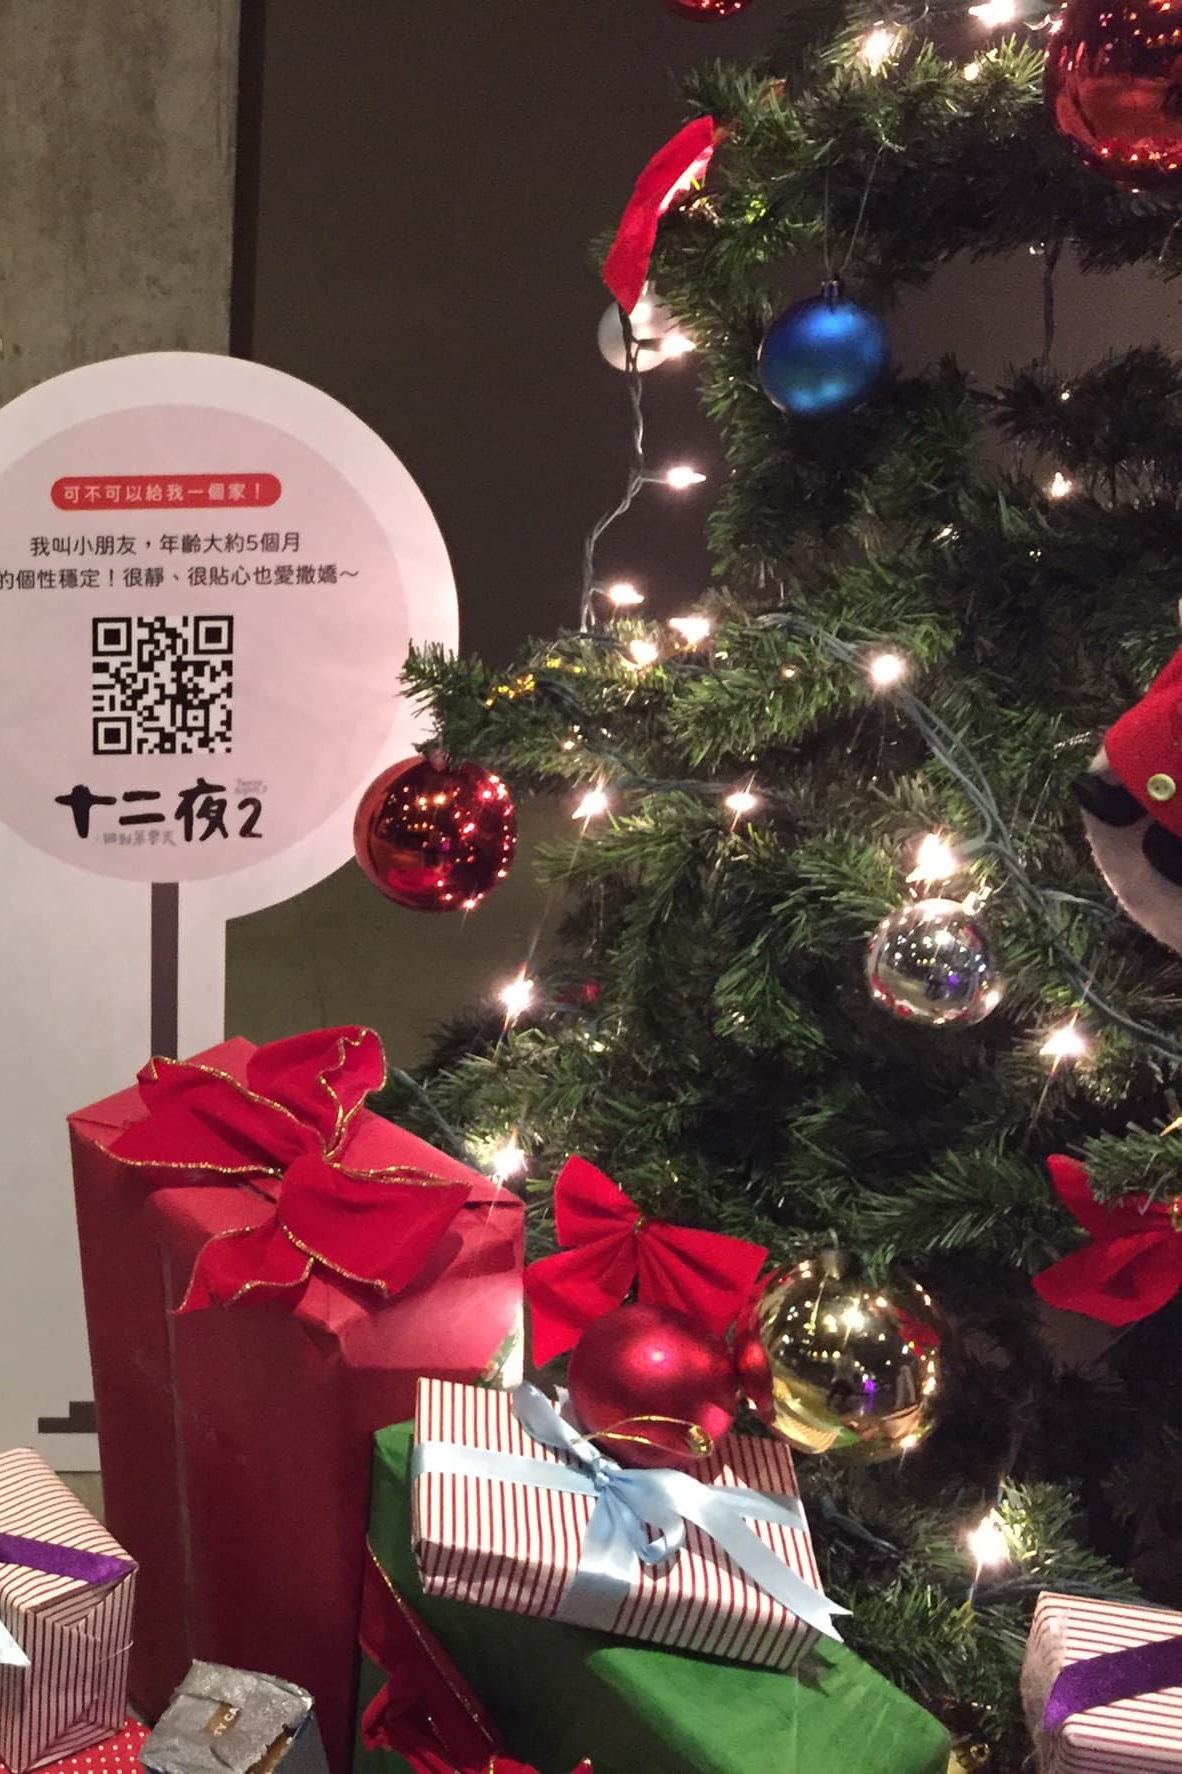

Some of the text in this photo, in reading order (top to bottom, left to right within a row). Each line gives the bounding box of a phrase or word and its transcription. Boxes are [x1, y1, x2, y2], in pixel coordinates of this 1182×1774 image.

[63, 481, 262, 504] 可不可以給我一個家！
[54, 777, 263, 842] 十二夜2
